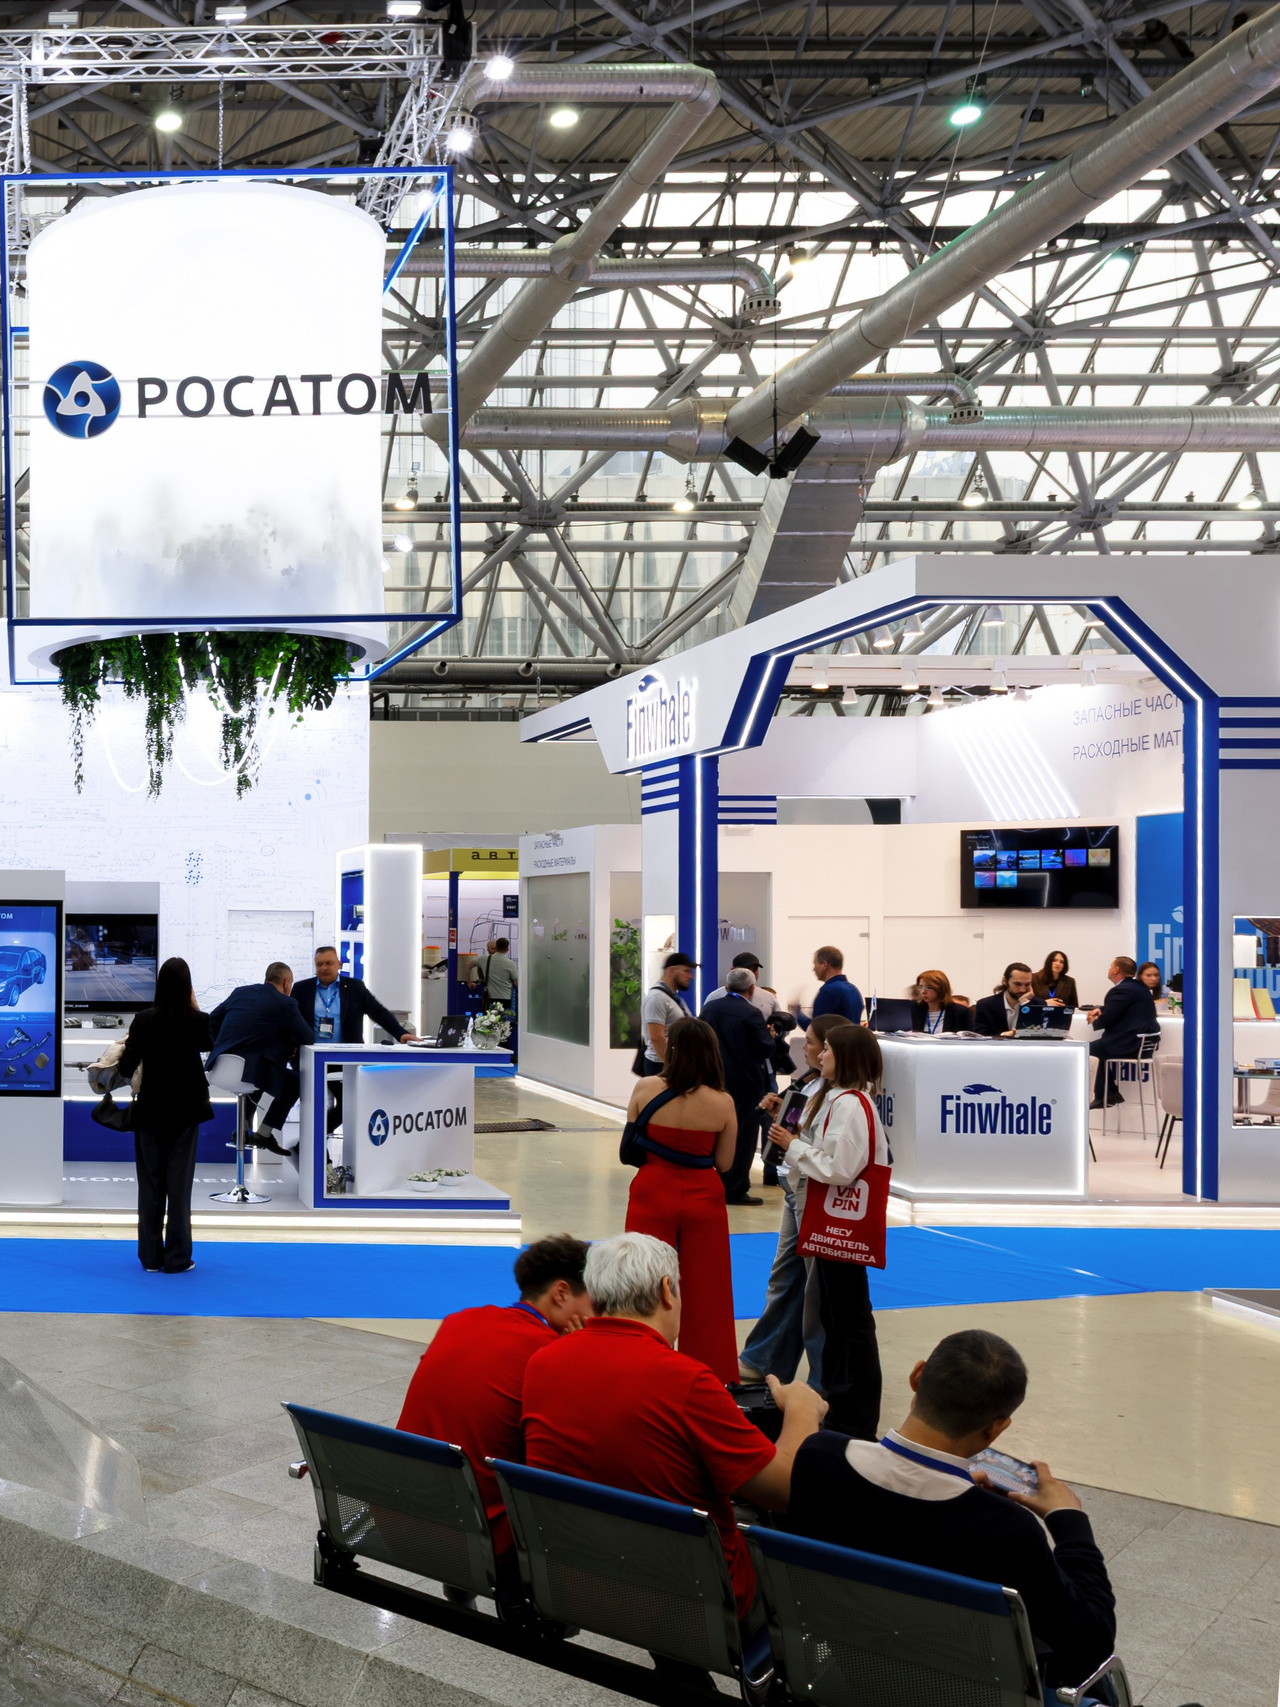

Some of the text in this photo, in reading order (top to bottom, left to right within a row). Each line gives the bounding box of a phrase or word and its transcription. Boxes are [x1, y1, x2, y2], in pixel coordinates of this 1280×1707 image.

[137, 372, 433, 418] РОСАТОМ
[626, 680, 690, 758] Finwhale
[1073, 699, 1142, 726] ЗАПАСНЫЕ
[1073, 729, 1182, 761] РАСХОДНЫЕ МАТ
[393, 1106, 467, 1135] РОСАТОМ
[941, 1094, 1052, 1135] Finwhale
[831, 1197, 860, 1213] PIN
[836, 1184, 861, 1200] VIN
[809, 1232, 870, 1252] ДВИГАТЕЛЬ
[825, 1225, 853, 1238] НЕСУ
[802, 1242, 876, 1264] АВТОБИЗНЕСА
